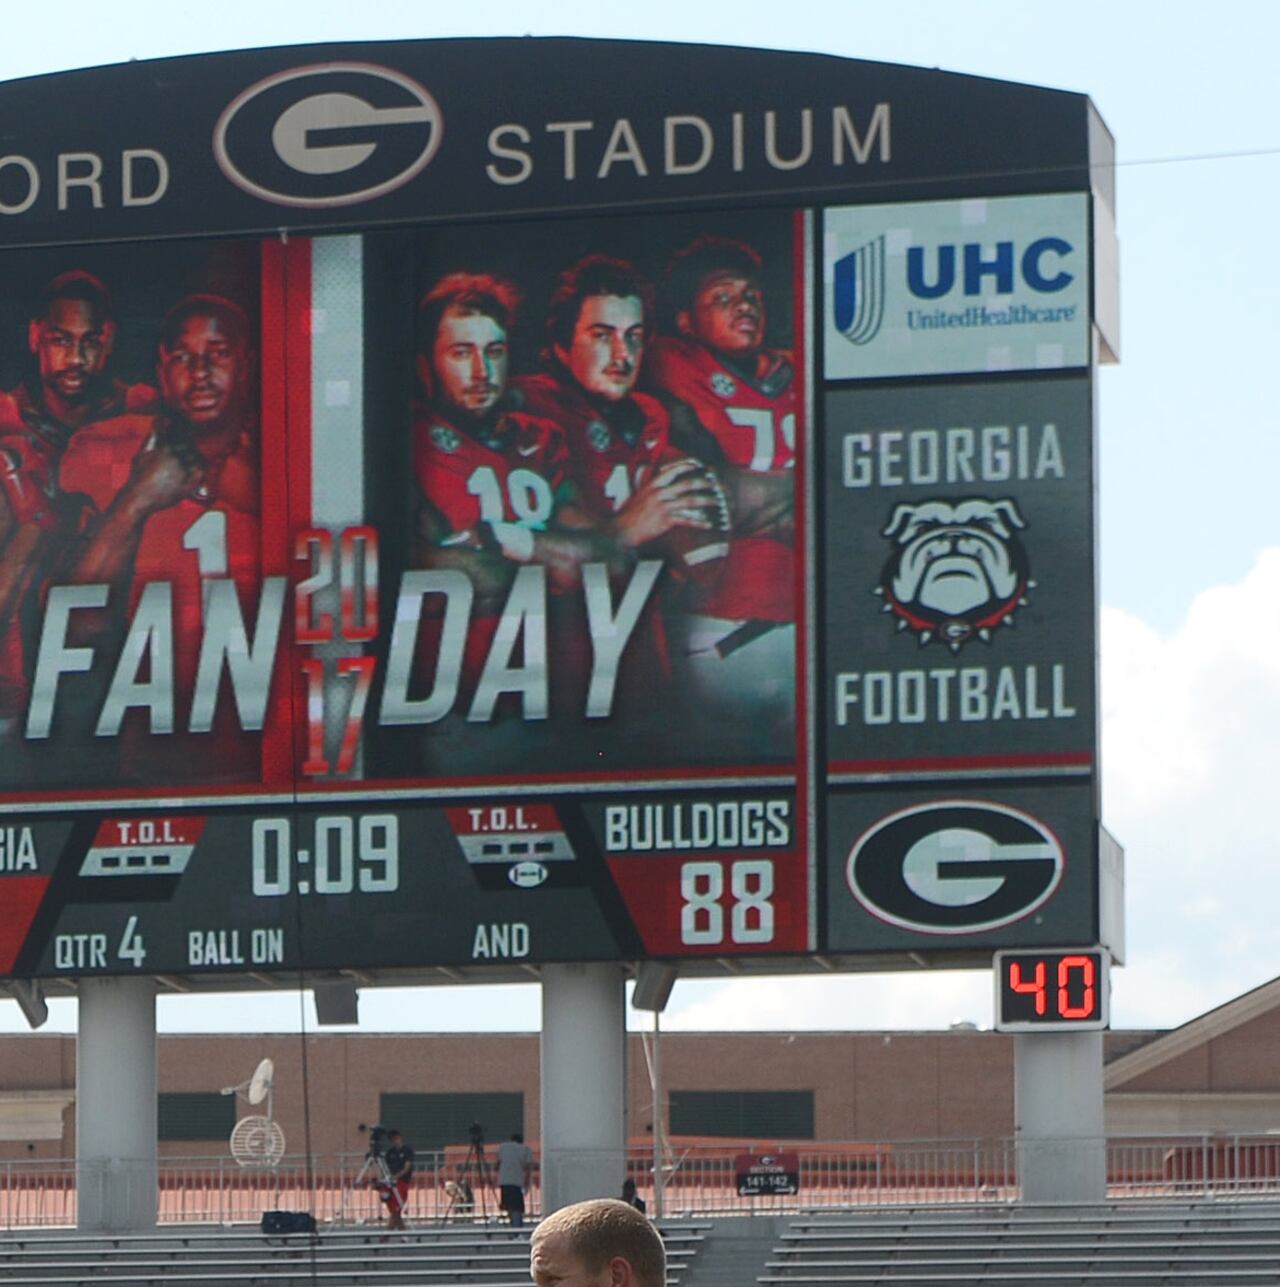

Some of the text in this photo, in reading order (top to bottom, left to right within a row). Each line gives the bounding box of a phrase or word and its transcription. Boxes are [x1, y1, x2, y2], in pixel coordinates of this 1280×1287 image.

[485, 102, 892, 186] STADIUM
[906, 236, 1075, 300] UHC
[907, 304, 1076, 331] UnitedHealthcare
[843, 424, 1065, 488] GEORGIA
[295, 525, 379, 644] 20
[24, 560, 665, 740] FAN DAY
[301, 656, 377, 775] 17
[835, 665, 1076, 726] FOOTBALL
[252, 814, 399, 897] 0:09
[605, 801, 790, 851] BULLDOGS
[680, 859, 775, 946] 88
[55, 916, 147, 969] QTR 4
[189, 930, 284, 966] BALL ON
[472, 922, 530, 960] AND
[1009, 955, 1095, 1019] 40
